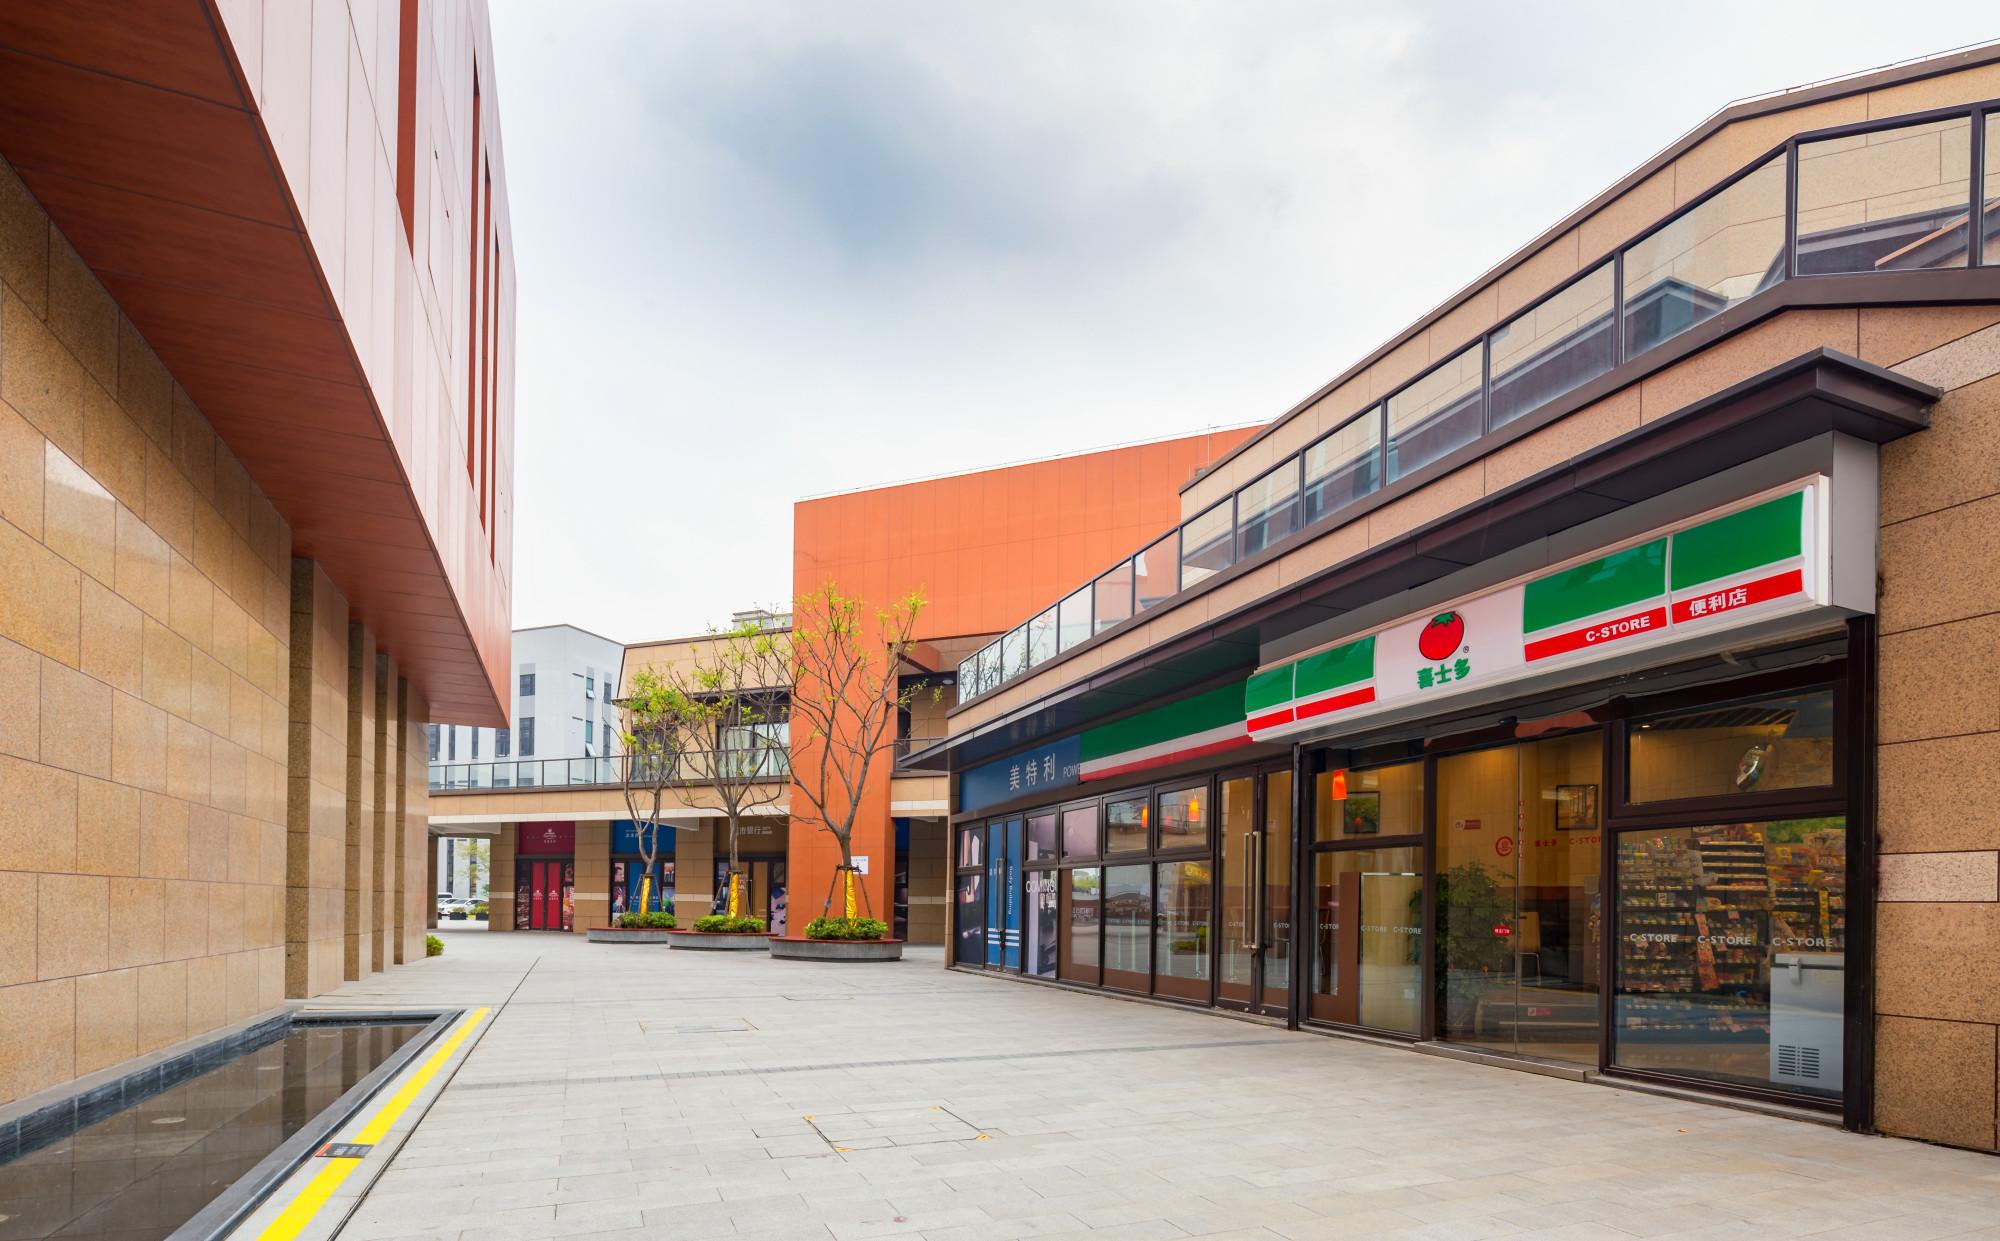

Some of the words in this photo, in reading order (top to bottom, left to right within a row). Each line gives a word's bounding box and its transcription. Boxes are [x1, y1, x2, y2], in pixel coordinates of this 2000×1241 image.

[1689, 588, 1747, 617] 便利店
[1585, 615, 1650, 642] C-STORE
[1416, 657, 1471, 690] 喜士多
[1009, 752, 1056, 791] 美特利
[1392, 926, 1423, 935] C-STORE
[1629, 933, 1678, 943] C-STORE
[1697, 935, 1752, 945] C-STORE
[1772, 936, 1834, 947] C-STORE
